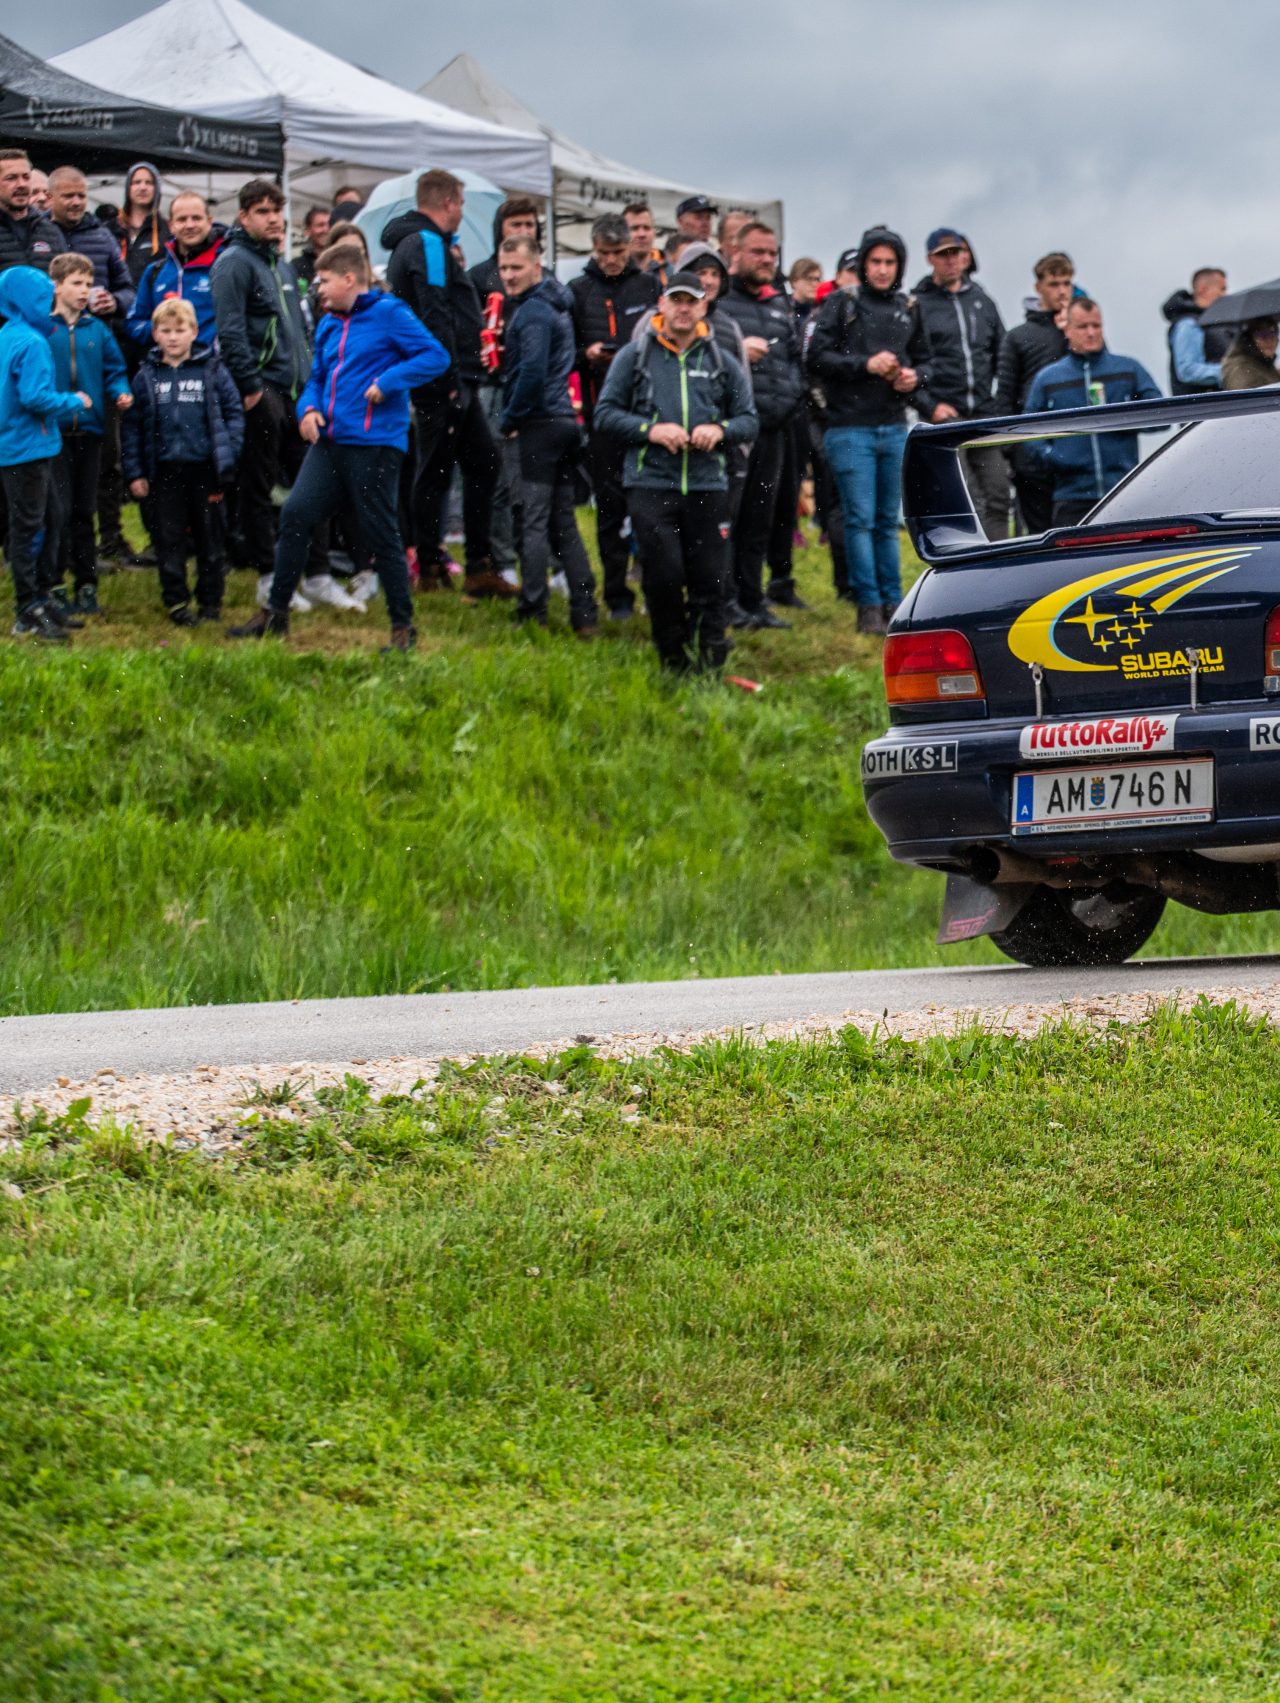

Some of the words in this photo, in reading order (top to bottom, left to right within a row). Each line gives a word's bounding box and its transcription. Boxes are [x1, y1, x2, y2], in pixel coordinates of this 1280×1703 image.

[1120, 646, 1225, 673] SUBARU
[1124, 671, 1160, 680] WORLD
[1162, 667, 1195, 678] RALLY
[1197, 664, 1225, 674] TEAM
[1029, 716, 1168, 750] TuttoRally+
[1046, 776, 1086, 814] AM
[1110, 770, 1165, 810] 746
[1174, 769, 1192, 804] N
[1020, 804, 1030, 816] A
